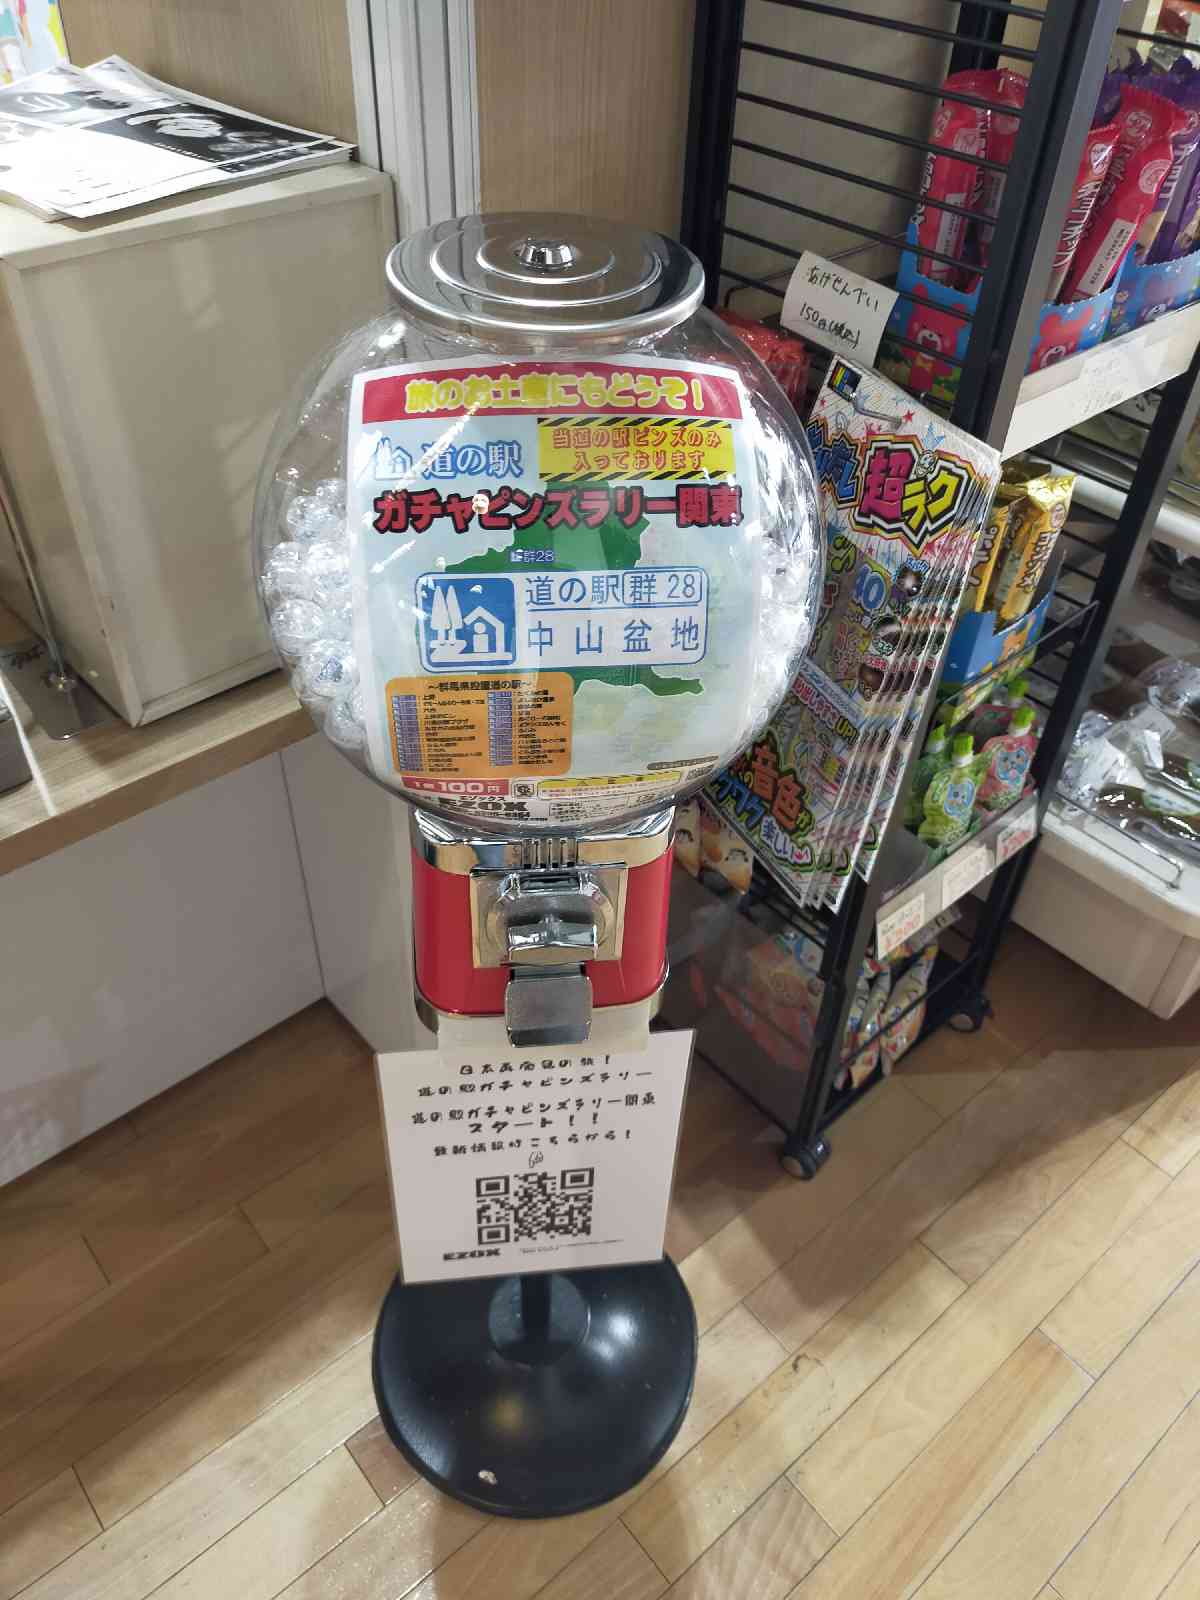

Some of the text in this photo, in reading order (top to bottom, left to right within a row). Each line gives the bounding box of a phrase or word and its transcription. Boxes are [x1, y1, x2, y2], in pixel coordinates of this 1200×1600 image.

[421, 438, 525, 479] 道の駅
[574, 450, 705, 471] 入っております
[374, 485, 742, 534] ガチャピンズラリー関東
[526, 574, 619, 606] 道の駅
[527, 617, 700, 656] 中山盆地
